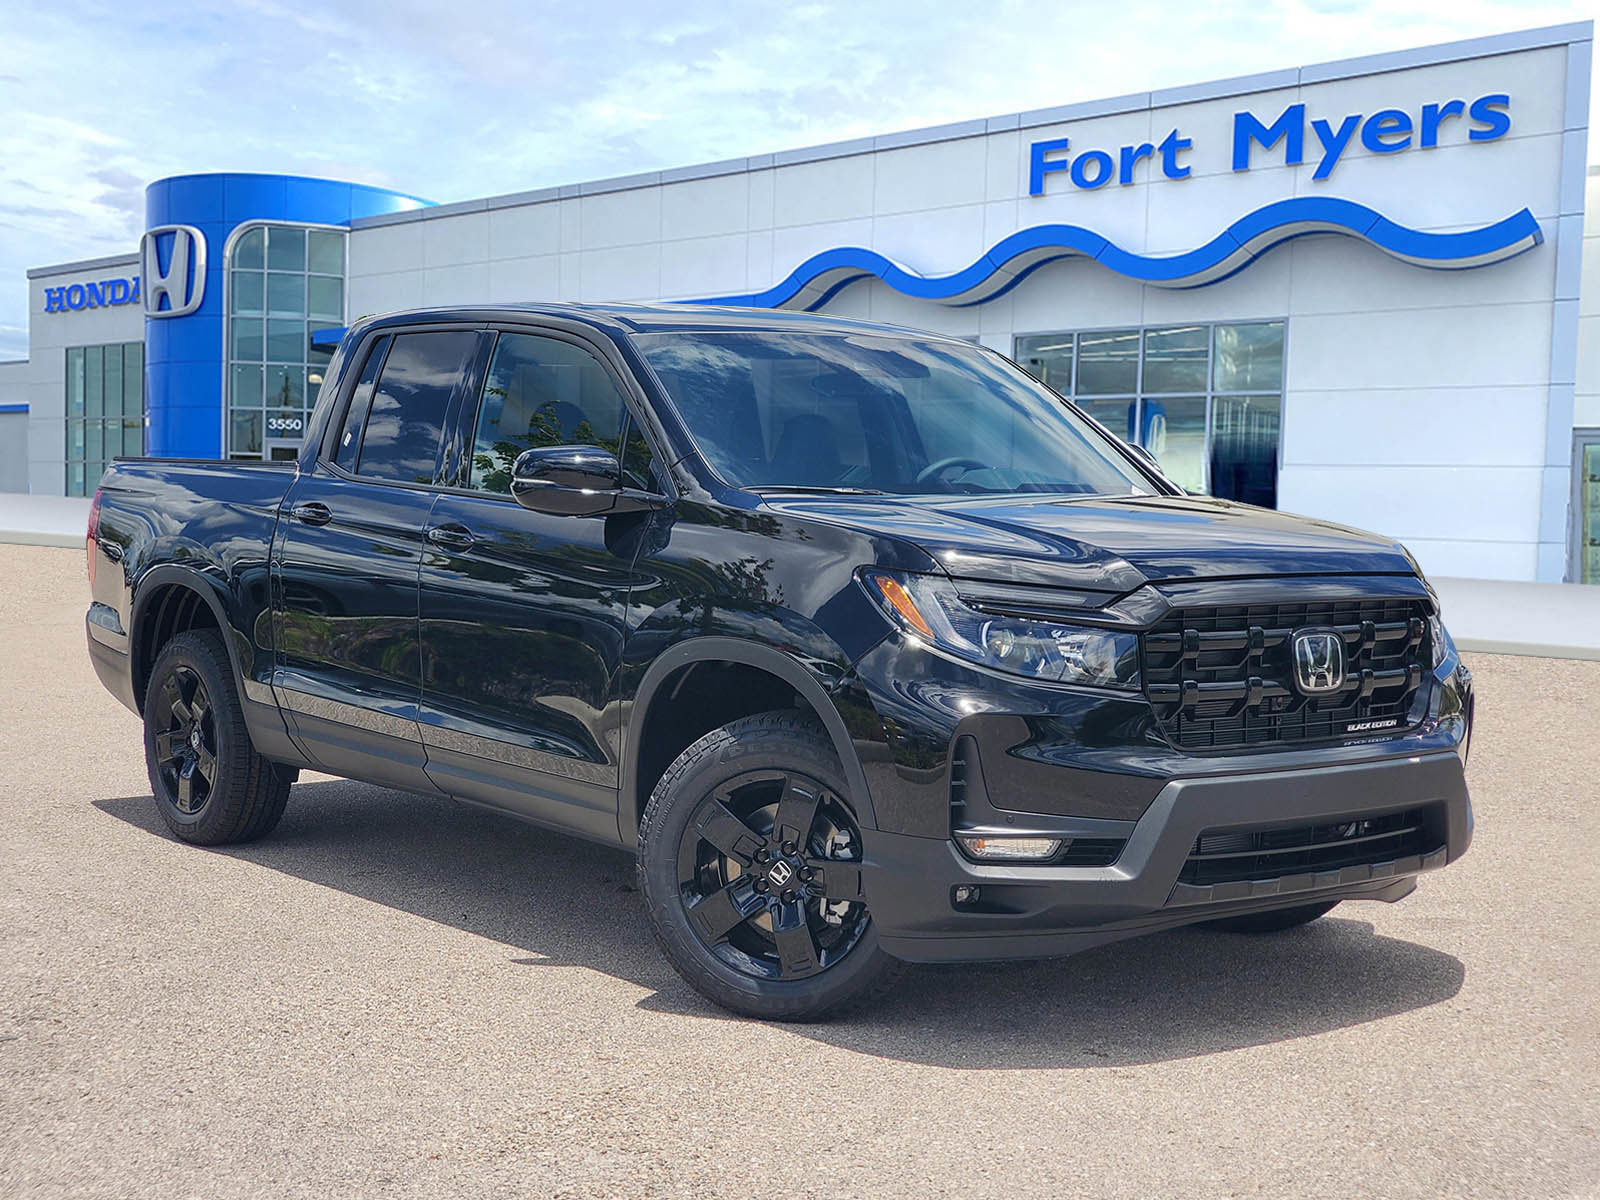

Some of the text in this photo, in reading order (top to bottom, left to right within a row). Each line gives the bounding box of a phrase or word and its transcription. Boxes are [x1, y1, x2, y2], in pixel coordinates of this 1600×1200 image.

[1029, 93, 1511, 196] Fort Myers
[268, 418, 302, 430] 3550
[1347, 719, 1398, 732] BLACK EDITION
